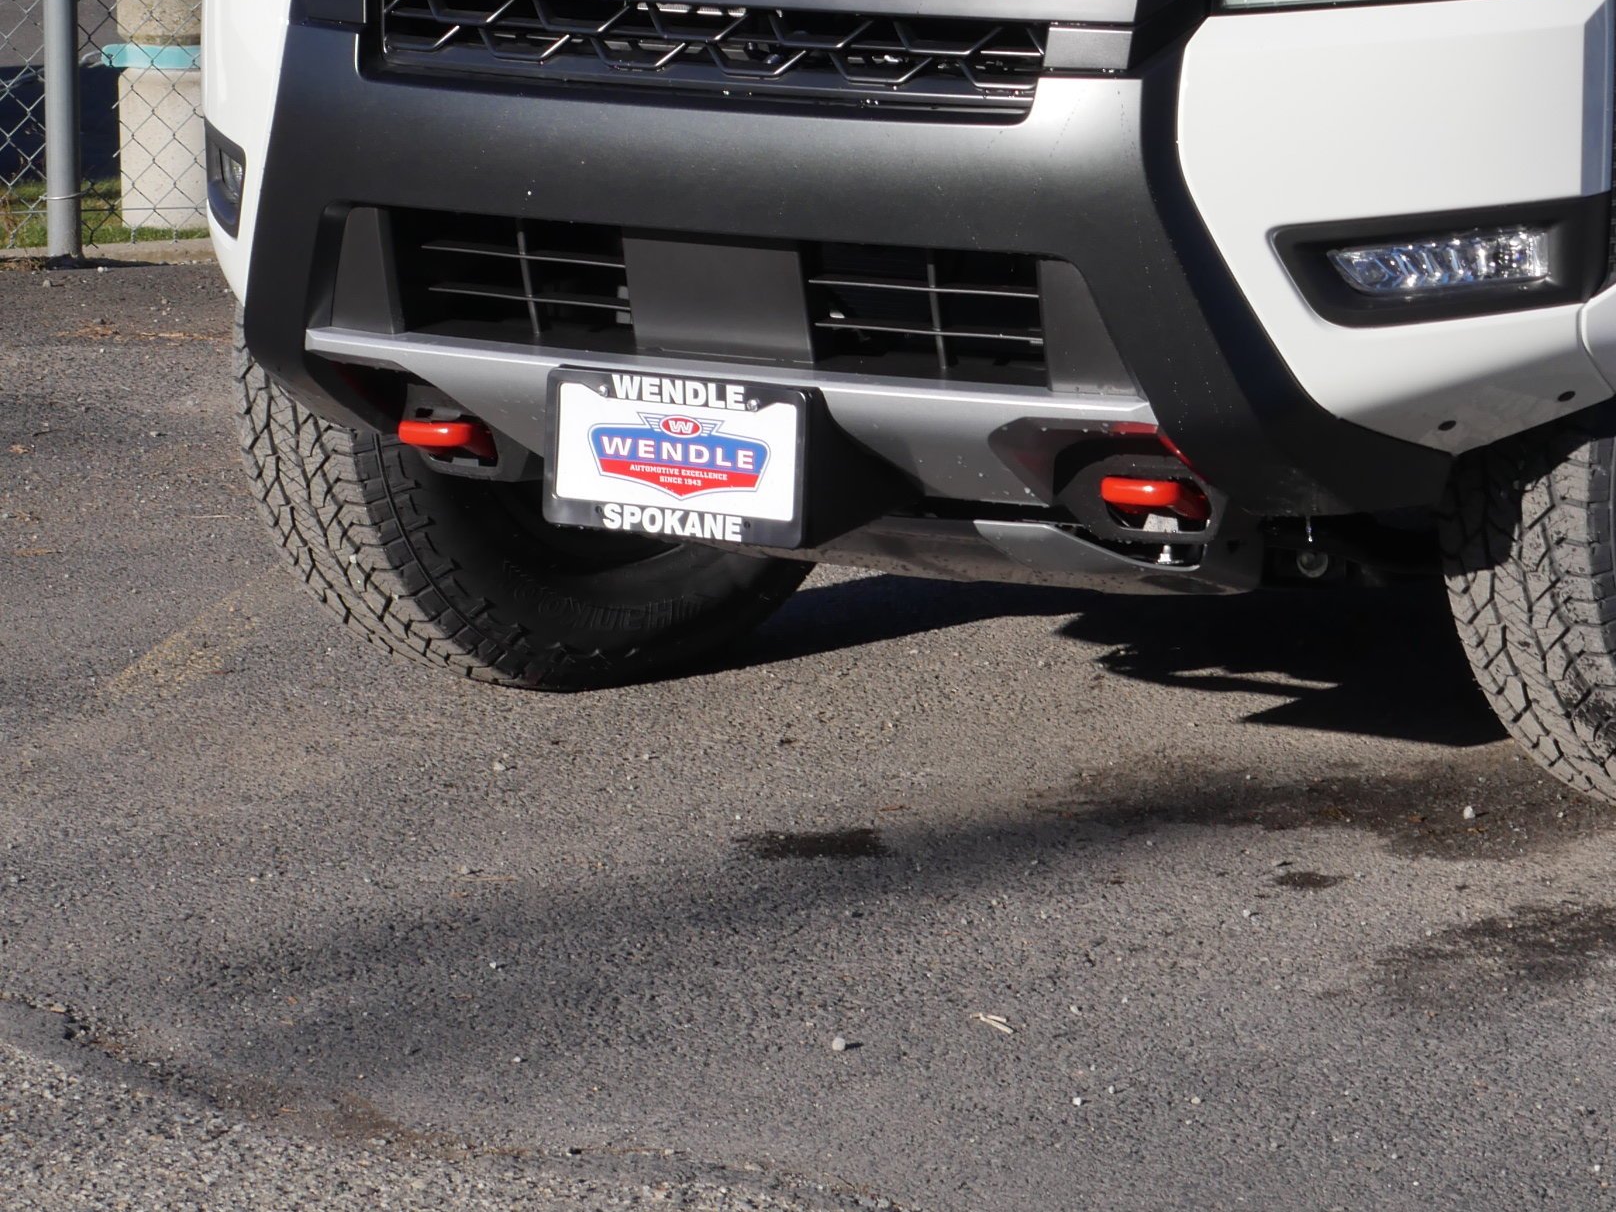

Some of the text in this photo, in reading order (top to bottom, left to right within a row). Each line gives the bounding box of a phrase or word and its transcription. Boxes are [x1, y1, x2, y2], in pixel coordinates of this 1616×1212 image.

[612, 374, 746, 411] WENDLE
[601, 436, 755, 470] WENDLE
[629, 464, 728, 481] AUTOMOTIVE EXCELLENCE
[659, 476, 702, 487] SINCE 1943
[602, 503, 742, 542] SPOKANE
